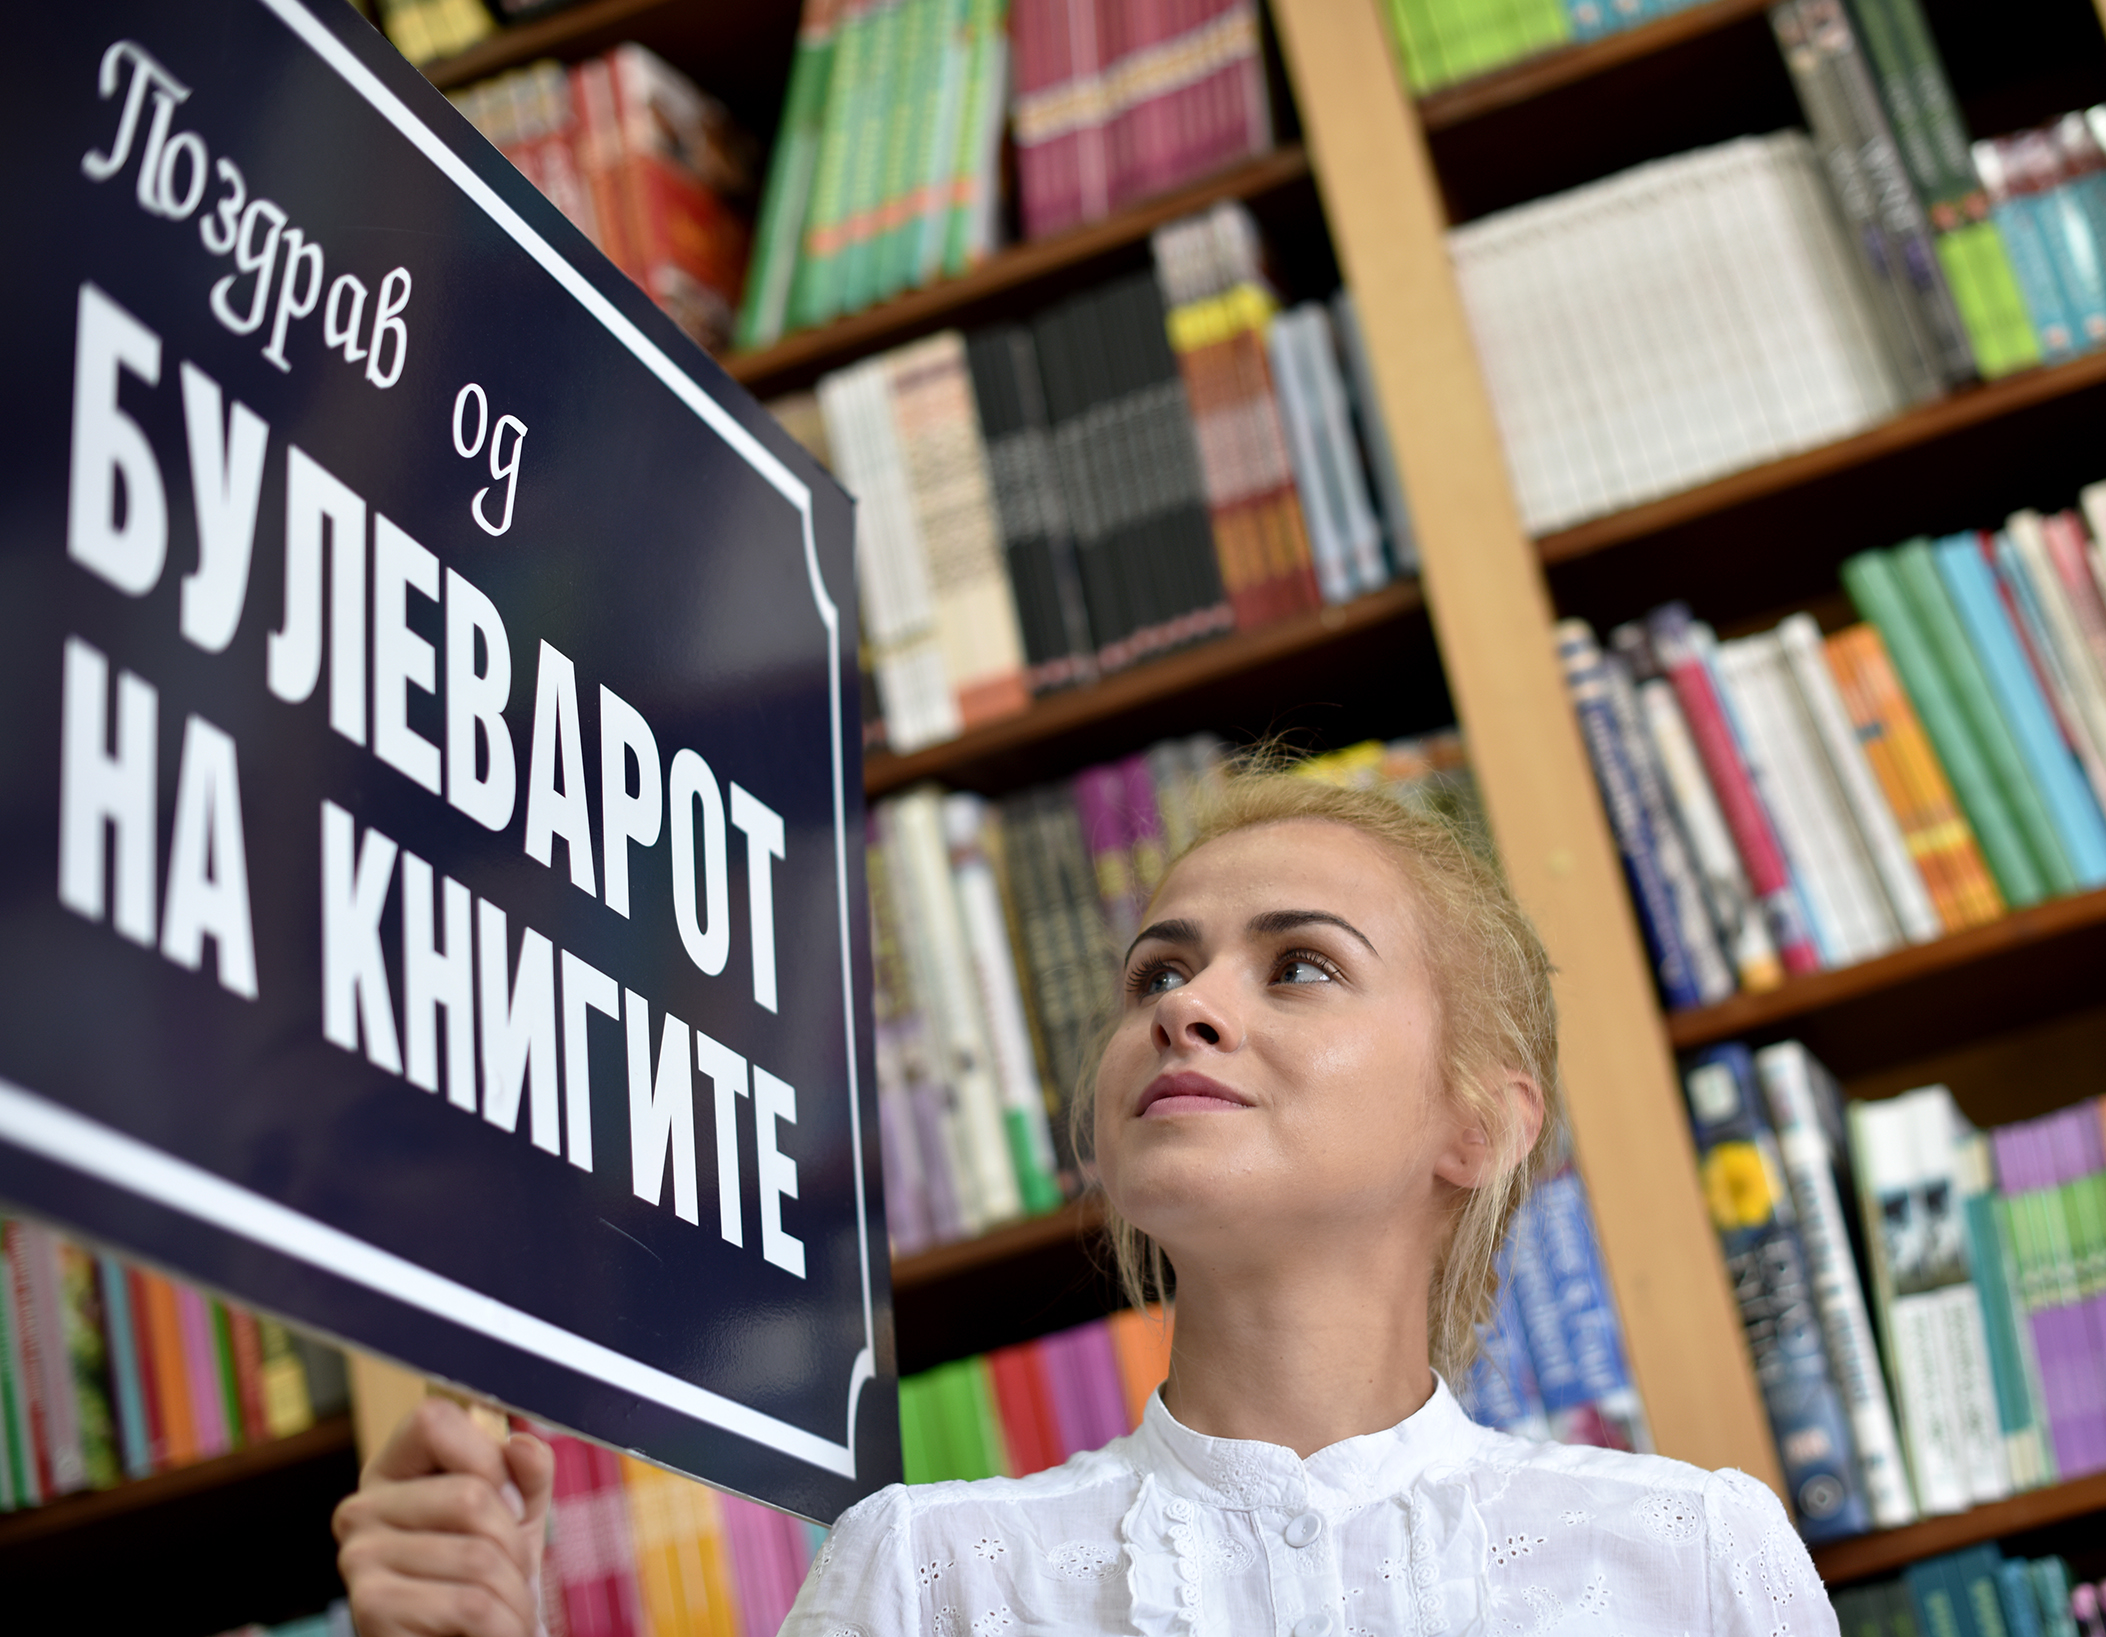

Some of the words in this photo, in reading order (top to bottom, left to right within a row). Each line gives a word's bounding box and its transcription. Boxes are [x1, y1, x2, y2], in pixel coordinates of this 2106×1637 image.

[83, 41, 412, 389] Поздрав
[452, 382, 529, 537] од
[59, 636, 259, 1000] НА
[321, 799, 806, 1280] КНИГИТЕ
[67, 282, 787, 1015] БУЛЕВАРОТ
